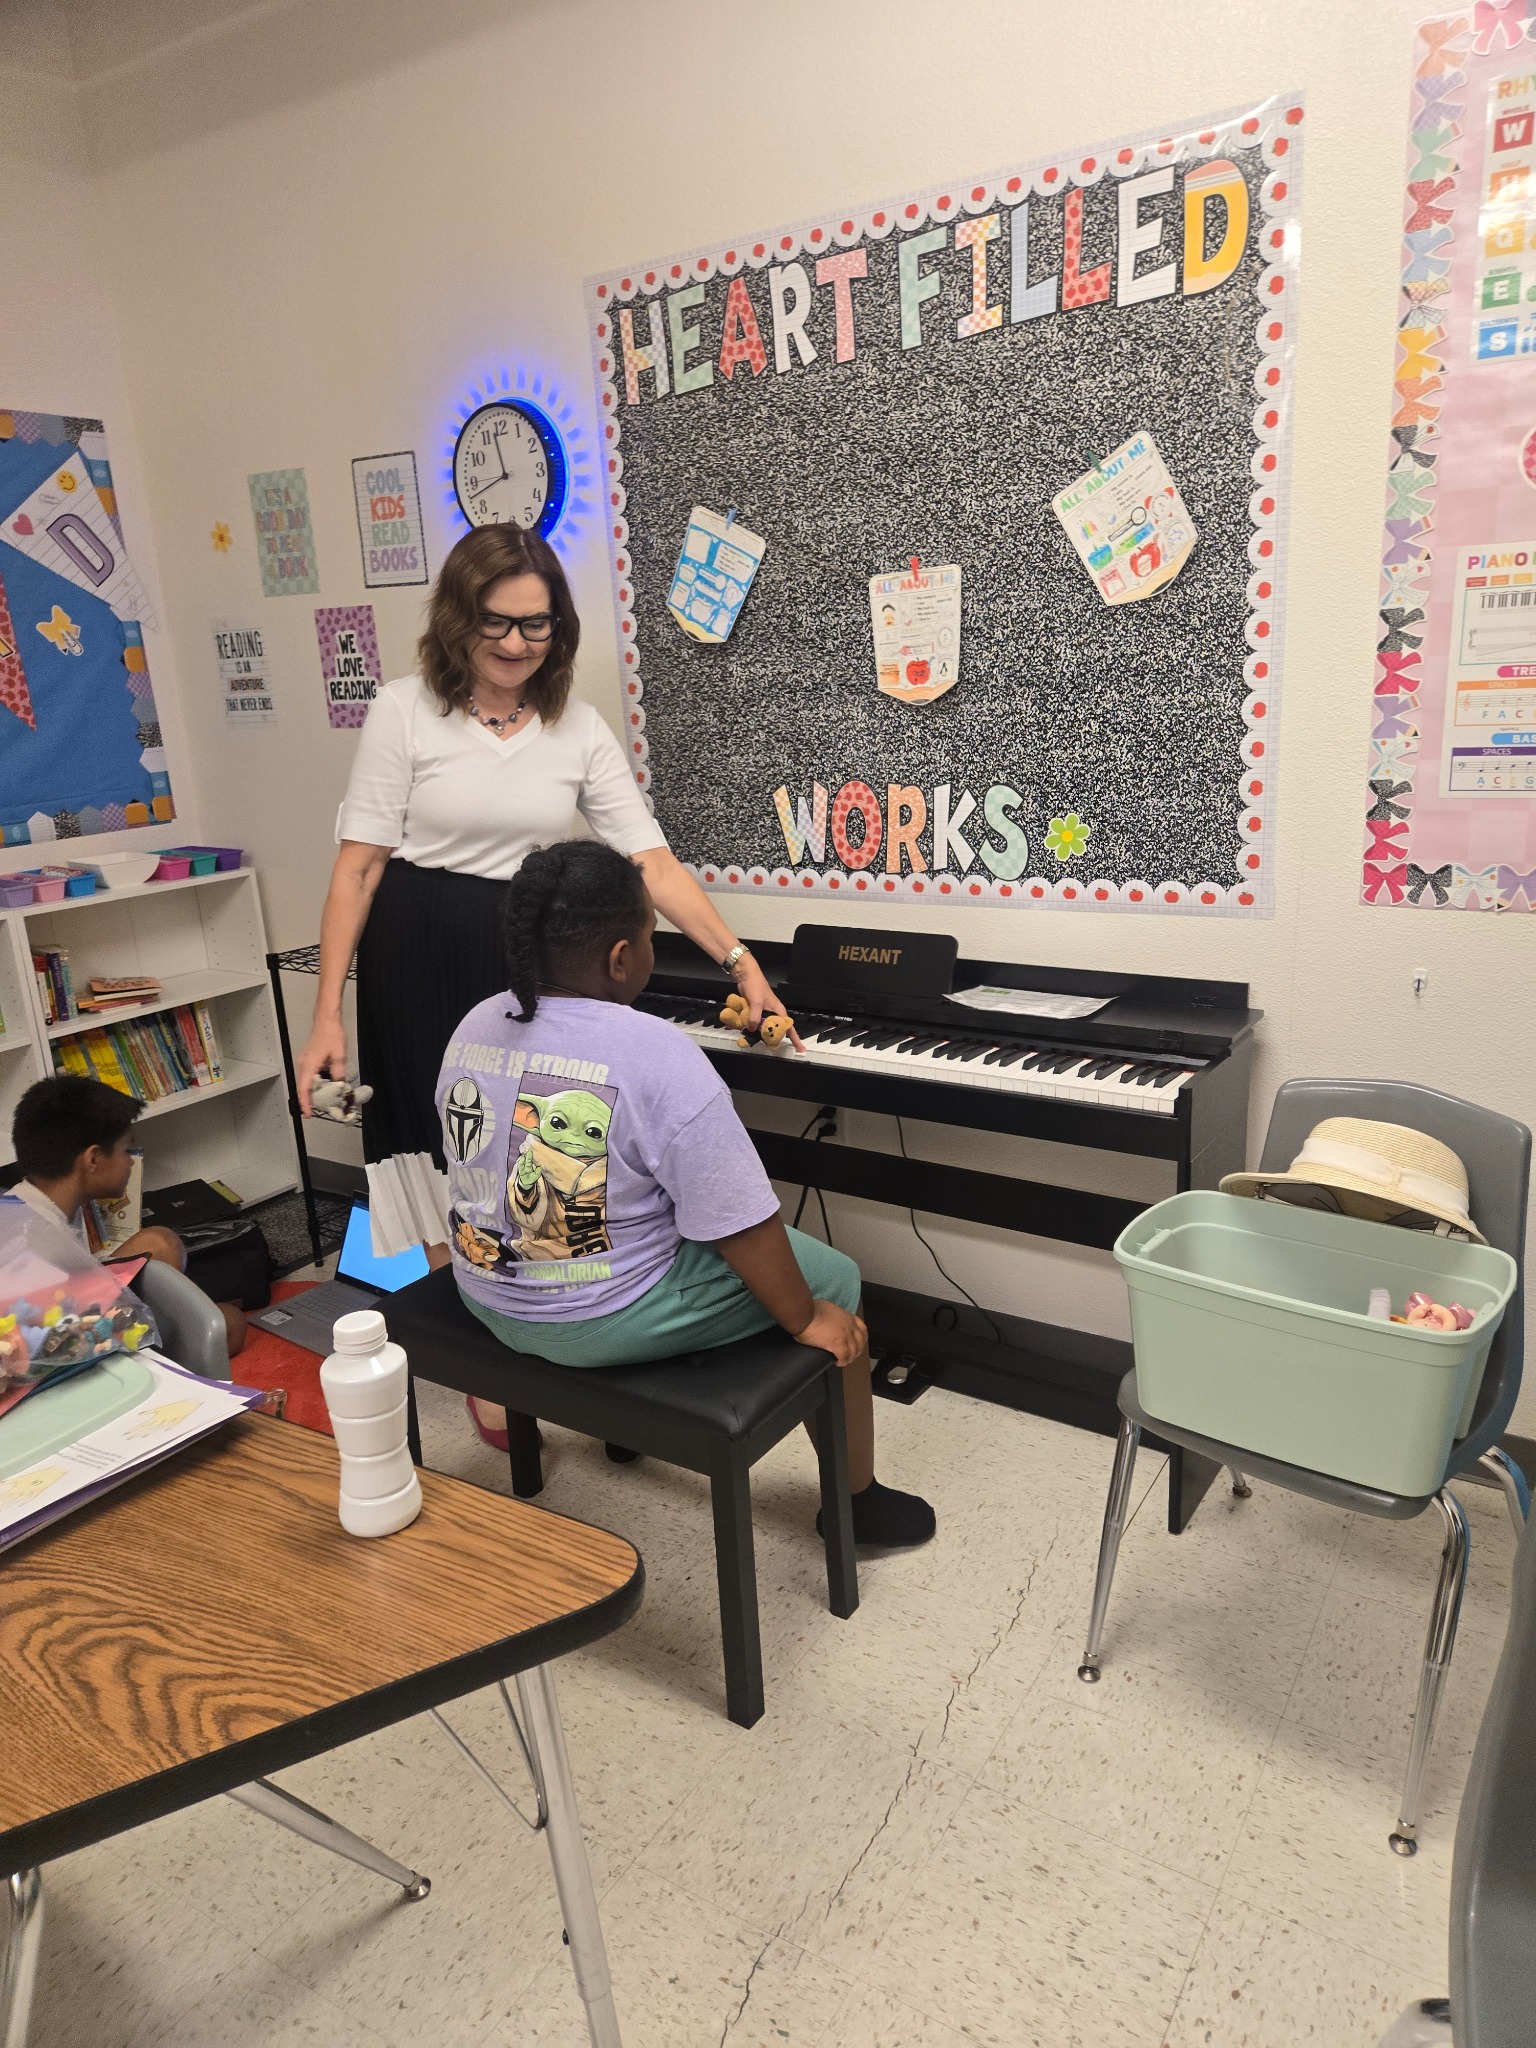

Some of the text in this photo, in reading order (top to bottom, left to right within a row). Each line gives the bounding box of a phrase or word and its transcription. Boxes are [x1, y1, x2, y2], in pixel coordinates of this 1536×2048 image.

[1502, 119, 1528, 144] W
[618, 159, 1250, 405] HEART FILLED
[1493, 279, 1510, 301] E
[1489, 331, 1508, 351] S
[481, 430, 491, 446] 11
[494, 420, 508, 437] 12
[515, 423, 521, 438] 1
[528, 438, 538, 454] 2
[470, 450, 486, 467] 10
[535, 461, 545, 478] 3
[1060, 438, 1148, 513] ALL ABOUT ME
[366, 468, 405, 495] COOL
[470, 476, 478, 491] 9
[533, 488, 542, 502] 4
[369, 494, 406, 522] KIDS
[480, 499, 488, 514] 8
[524, 507, 534, 522] 5
[371, 520, 410, 547] READ
[46, 513, 115, 587] D
[369, 546, 419, 573] BOOKS
[1468, 552, 1528, 570] PIANO
[875, 580, 894, 594] ALL
[900, 574, 935, 591] ABOUT
[216, 630, 263, 659] READING
[338, 633, 357, 654] WE
[243, 660, 252, 673] AN
[337, 656, 365, 678] LOVE
[230, 678, 265, 691] ADVENTURE
[329, 680, 377, 701] READING
[226, 697, 273, 711] THAT NEVER ENDS
[1497, 710, 1506, 718] A
[1515, 710, 1523, 718] C
[1482, 748, 1512, 756] SPACES
[1493, 776, 1501, 784] C
[1525, 776, 1534, 784] G
[773, 780, 1029, 881] WORKS
[838, 945, 902, 966] HEXANT
[459, 1043, 506, 1075] FORCE
[506, 1051, 527, 1079] IS
[528, 1053, 609, 1092] STRONG
